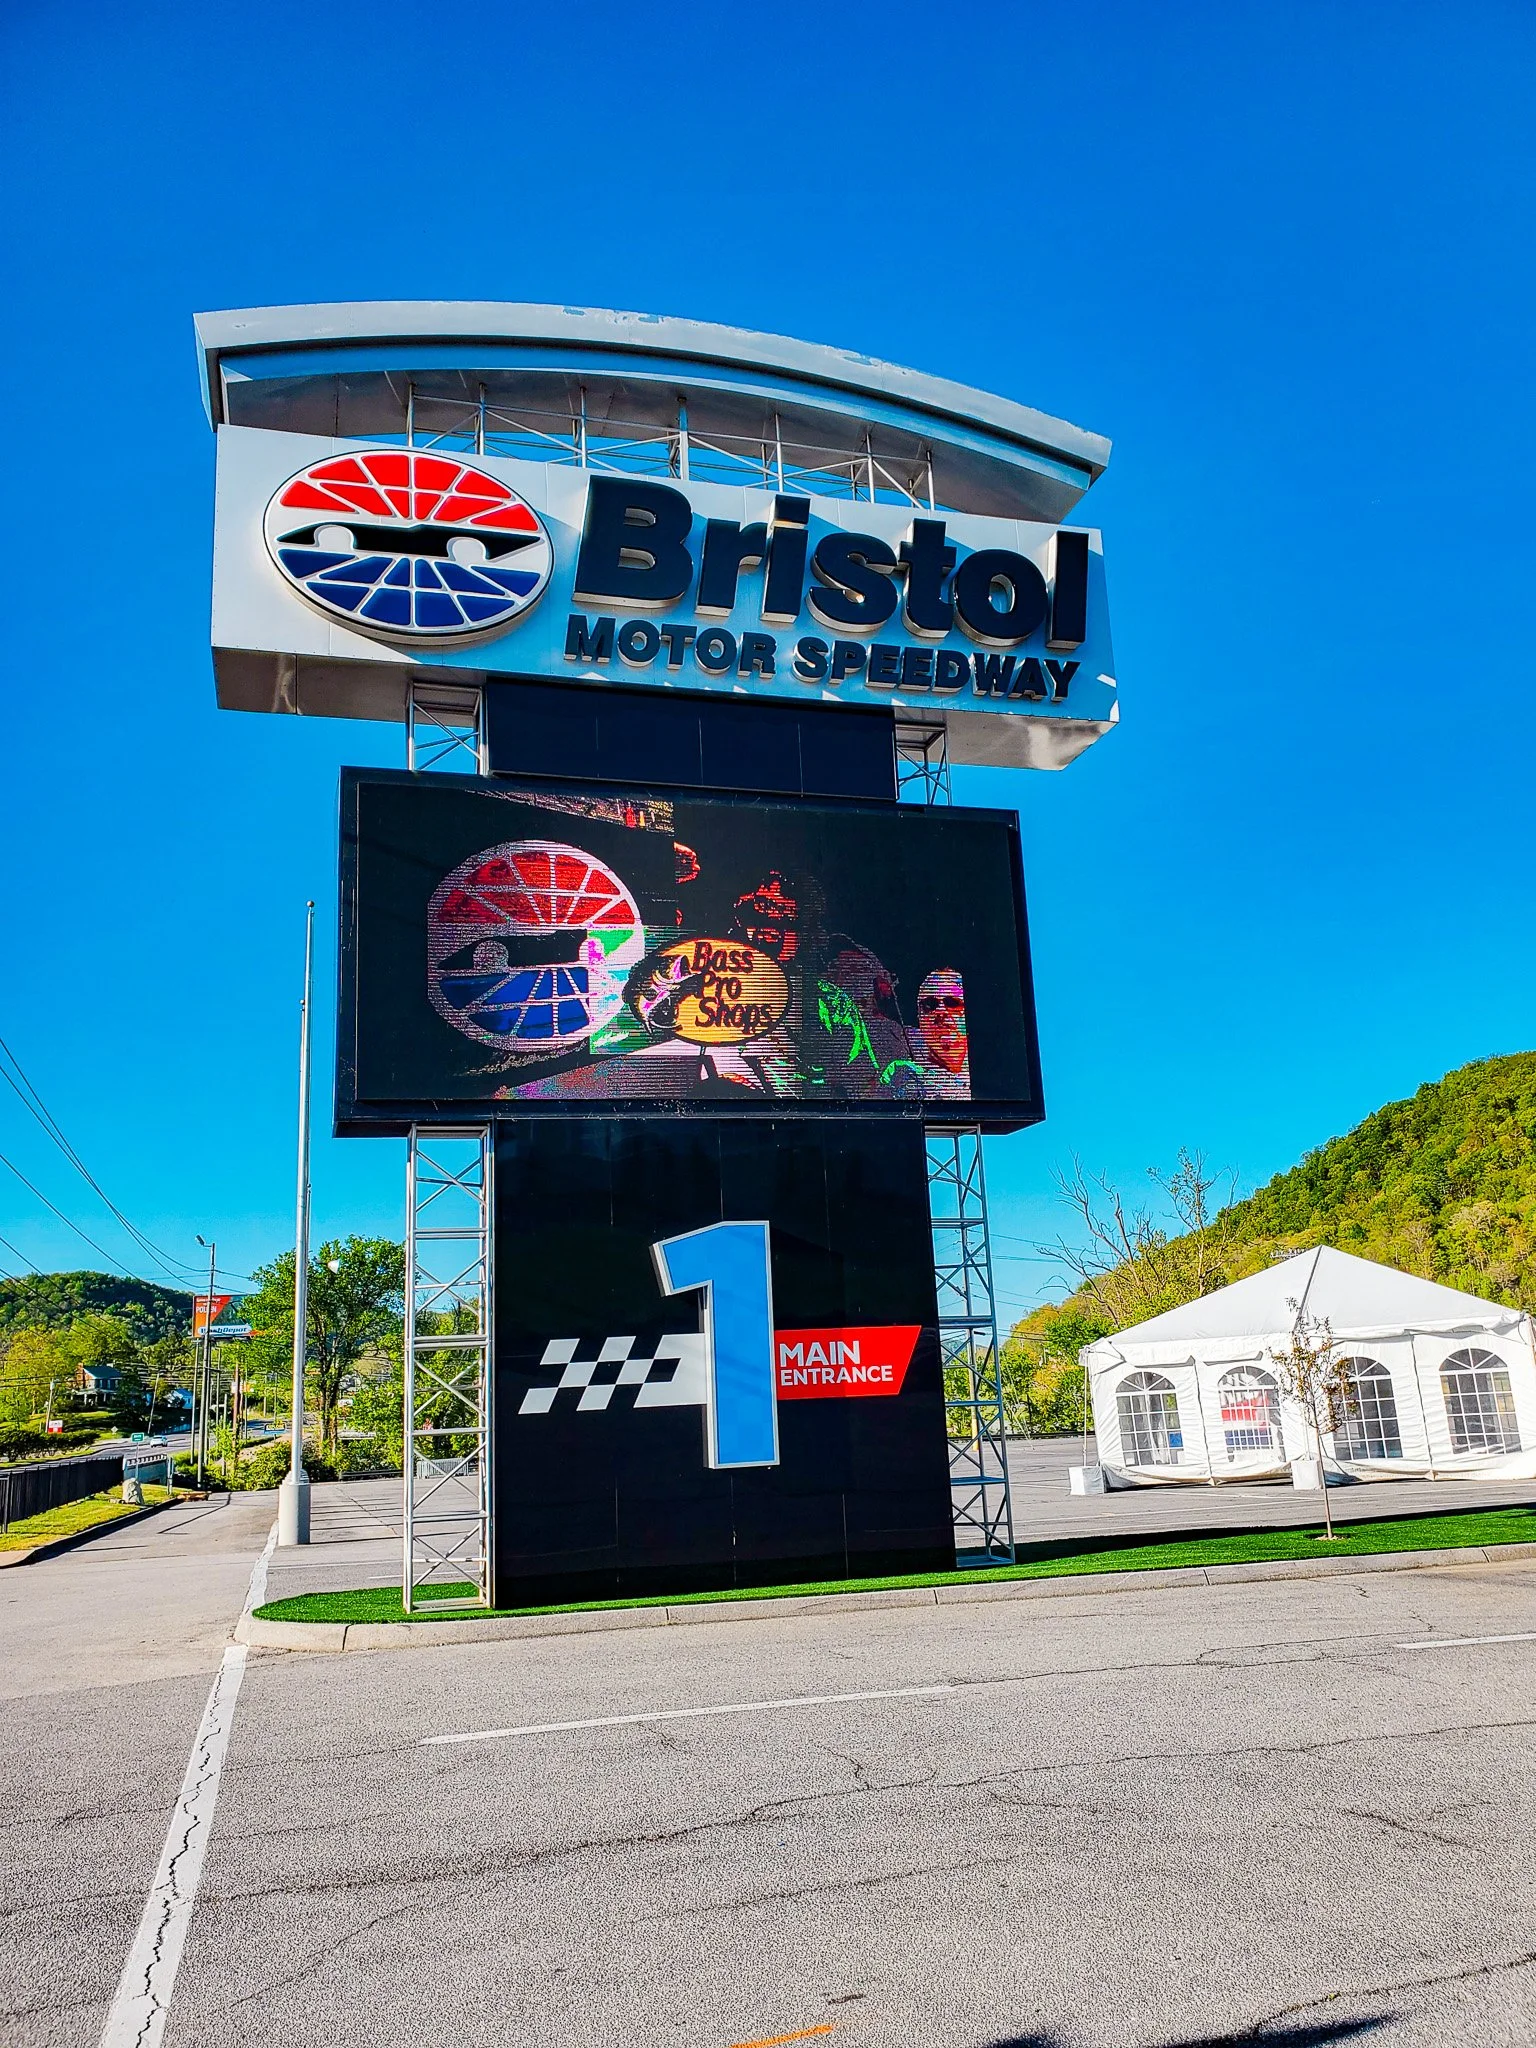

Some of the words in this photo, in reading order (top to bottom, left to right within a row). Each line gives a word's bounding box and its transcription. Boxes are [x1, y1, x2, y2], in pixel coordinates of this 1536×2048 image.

[571, 475, 1089, 649] Bristol
[563, 614, 777, 678] MOTOR
[792, 636, 1081, 701] SPEEDWAY
[691, 942, 754, 973] Bass
[698, 970, 742, 1002] Pro
[695, 997, 772, 1034] Shops
[195, 1305, 217, 1313] POLEN
[649, 1220, 780, 1469] 1
[780, 1340, 860, 1368] MAIN
[780, 1365, 894, 1386] ENTRANCE
